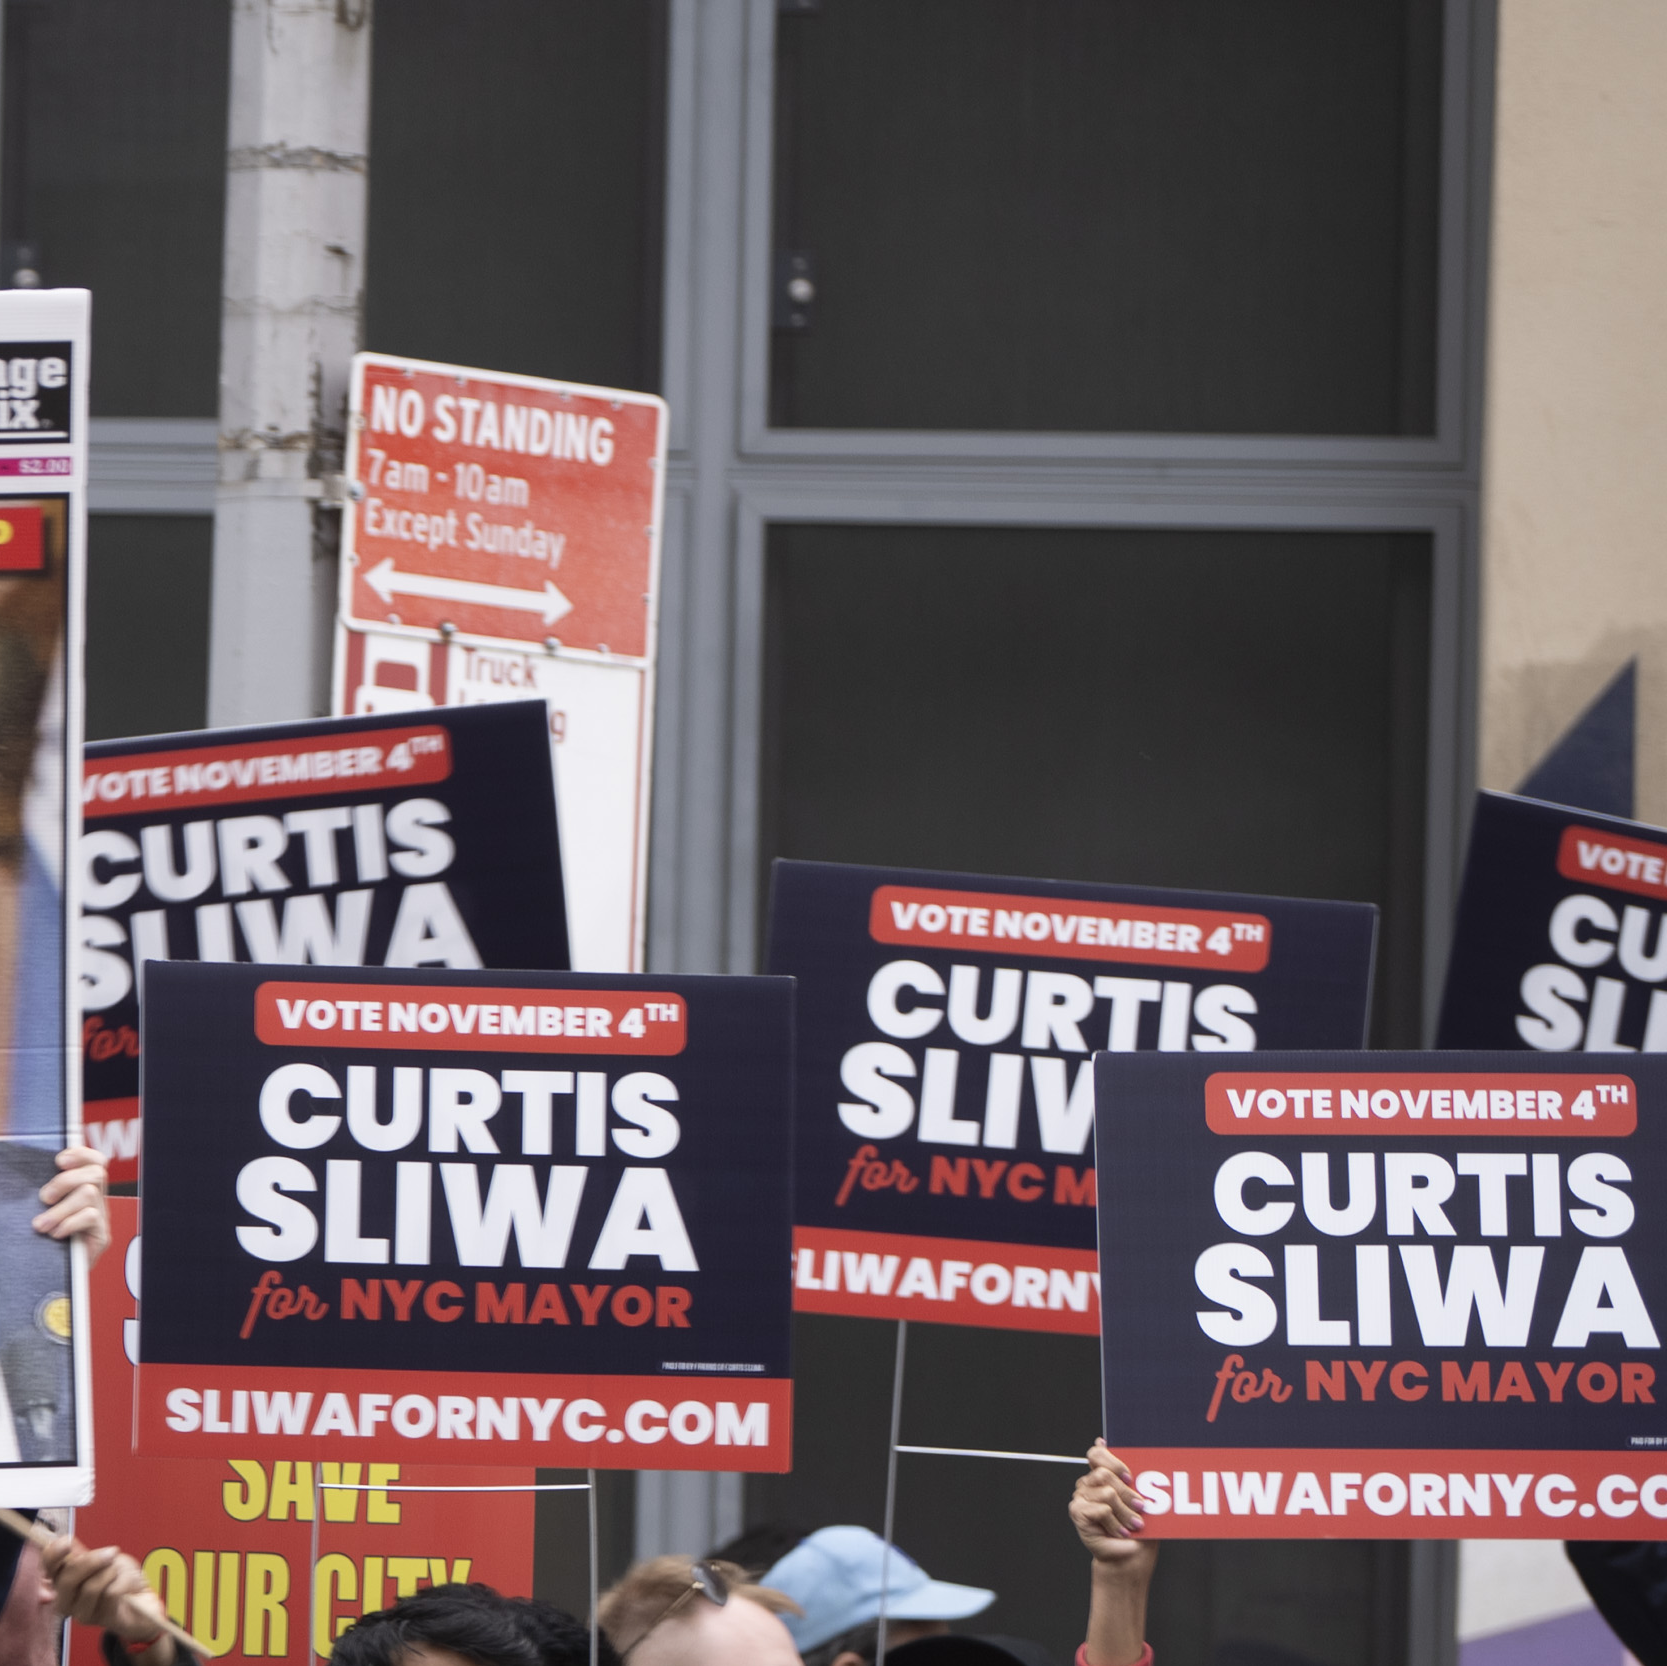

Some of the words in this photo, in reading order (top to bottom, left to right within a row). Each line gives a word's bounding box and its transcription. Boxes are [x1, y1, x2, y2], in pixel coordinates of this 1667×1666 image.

[371, 384, 423, 435] NO
[433, 394, 614, 466] STANDING
[366, 449, 428, 493] 7am
[453, 461, 530, 508] 10am
[364, 500, 459, 549] Except
[465, 516, 566, 569] Sunday
[458, 648, 538, 690] Truck
[278, 997, 383, 1032] VOTE
[388, 1002, 612, 1039] NOVEMBER
[618, 1003, 681, 1038] 4TH
[866, 958, 1259, 1052] CURTIS
[258, 1062, 681, 1158] CURTIS
[1226, 1089, 1333, 1119] VOTE
[1340, 1089, 1562, 1120] NOVEMBER
[1570, 1085, 1628, 1120] 4TH
[235, 1155, 701, 1272] SLIWA
[1213, 1152, 1636, 1238] CURTIS
[240, 1271, 331, 1340] for
[338, 1278, 463, 1324] NYC
[475, 1281, 693, 1328] MAYOR
[1194, 1242, 1661, 1348] SLIWA
[165, 1387, 770, 1448] SLIWAFORNYC.COM
[1206, 1355, 1293, 1421] for
[1305, 1360, 1429, 1402] NYC
[1440, 1361, 1657, 1403] MAYOR
[222, 1459, 401, 1525] SAVE
[141, 1547, 290, 1659] OUR
